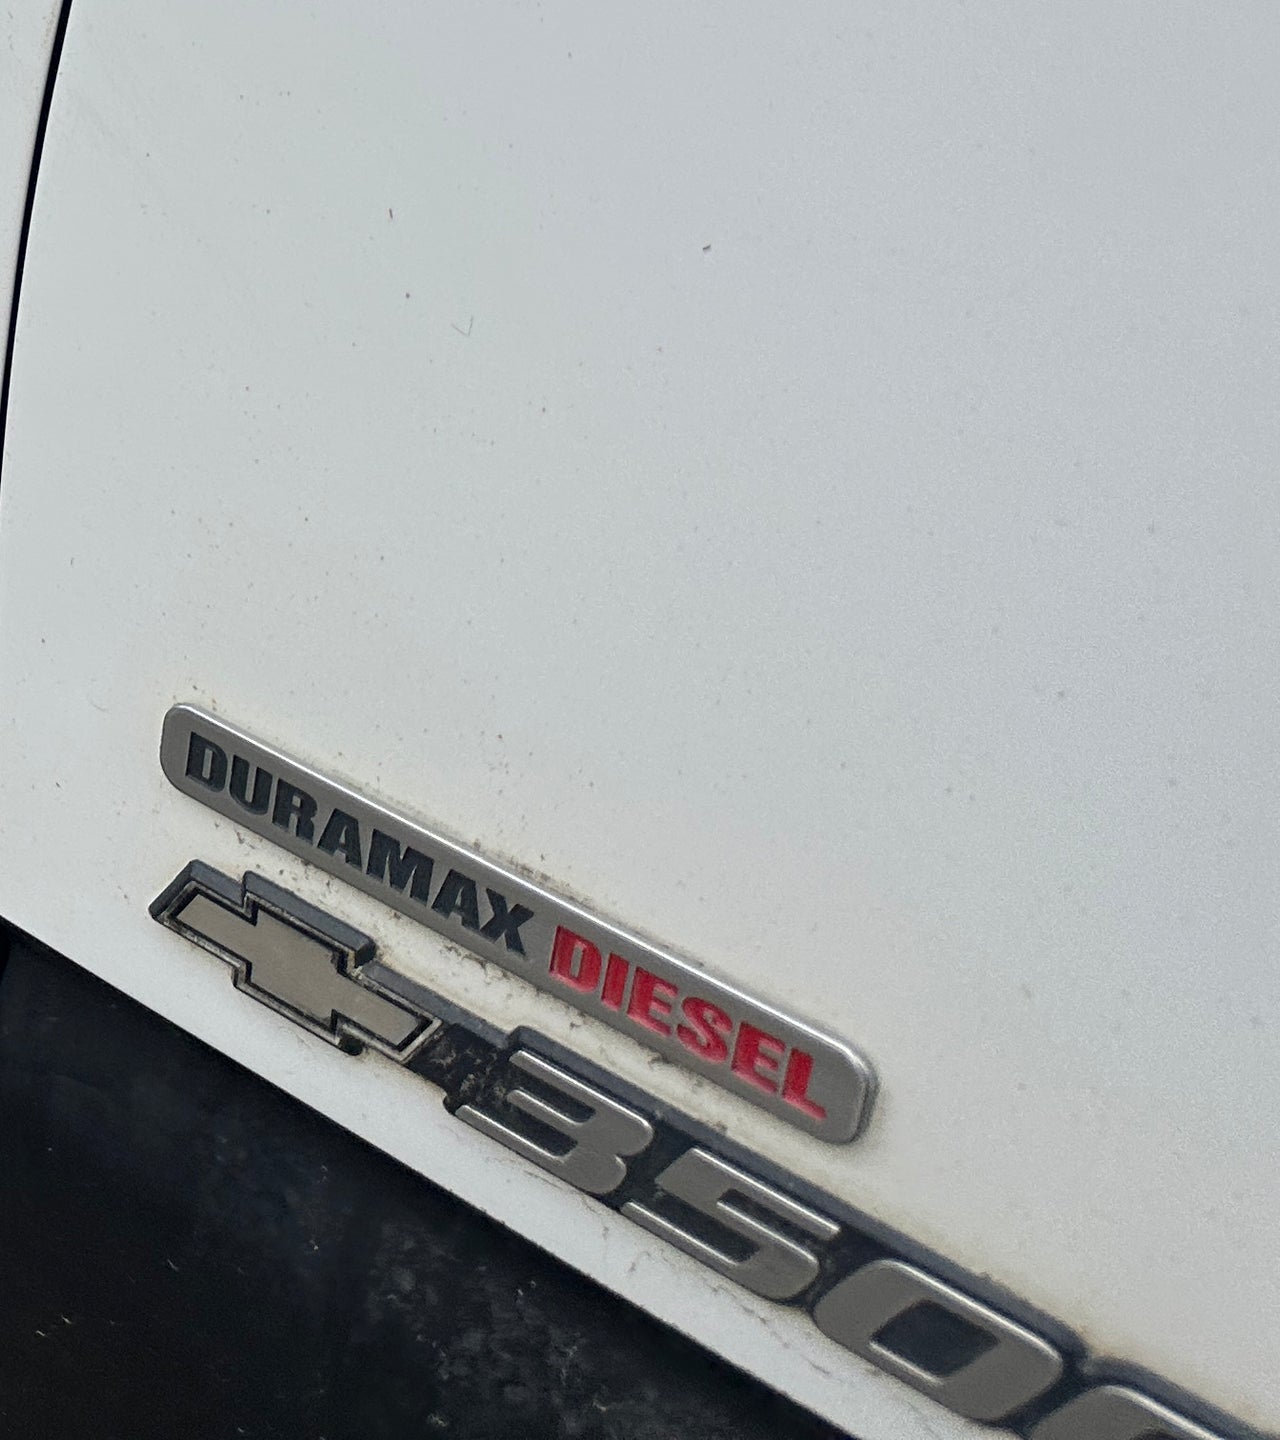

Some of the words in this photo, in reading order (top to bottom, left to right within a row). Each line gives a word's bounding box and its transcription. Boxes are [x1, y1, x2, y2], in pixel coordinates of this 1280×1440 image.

[184, 731, 535, 957] DURAMAX
[548, 924, 827, 1121] DIESEL
[454, 1048, 1228, 1440] 350
